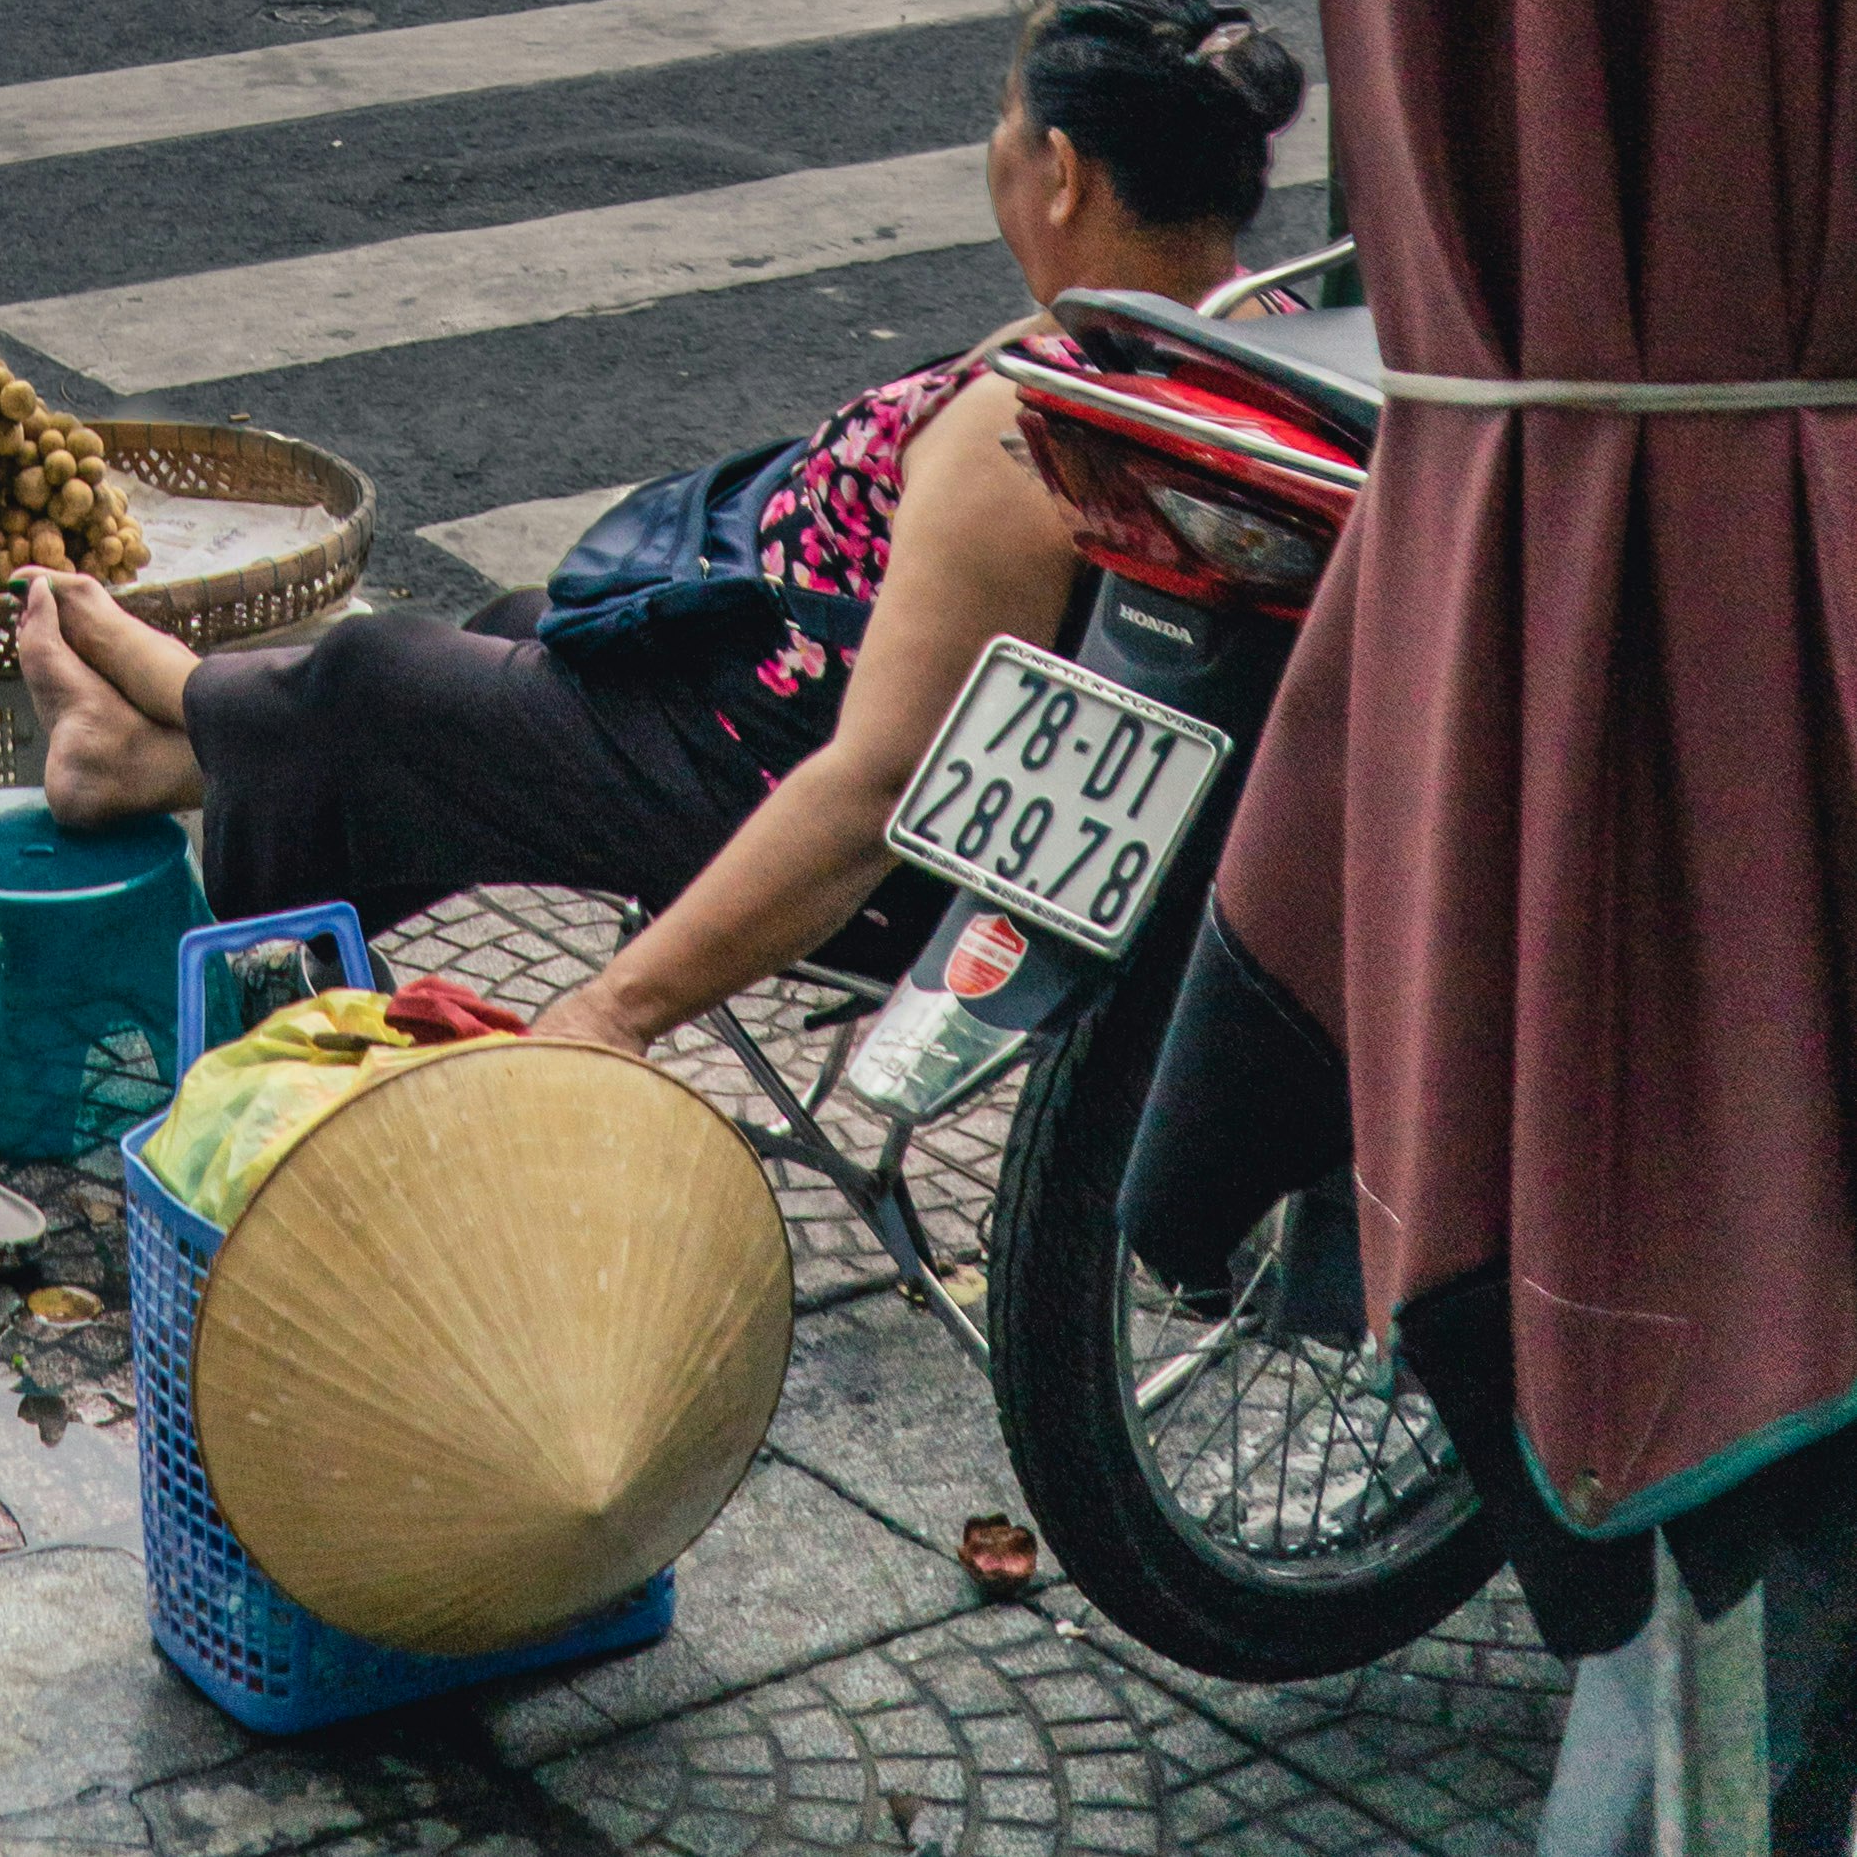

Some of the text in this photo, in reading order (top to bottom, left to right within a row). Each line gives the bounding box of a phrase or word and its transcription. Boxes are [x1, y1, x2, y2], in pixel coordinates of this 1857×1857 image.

[1118, 603, 1195, 646] HONDA
[984, 672, 1181, 819] 78-D1
[912, 760, 1151, 927] 289.78
